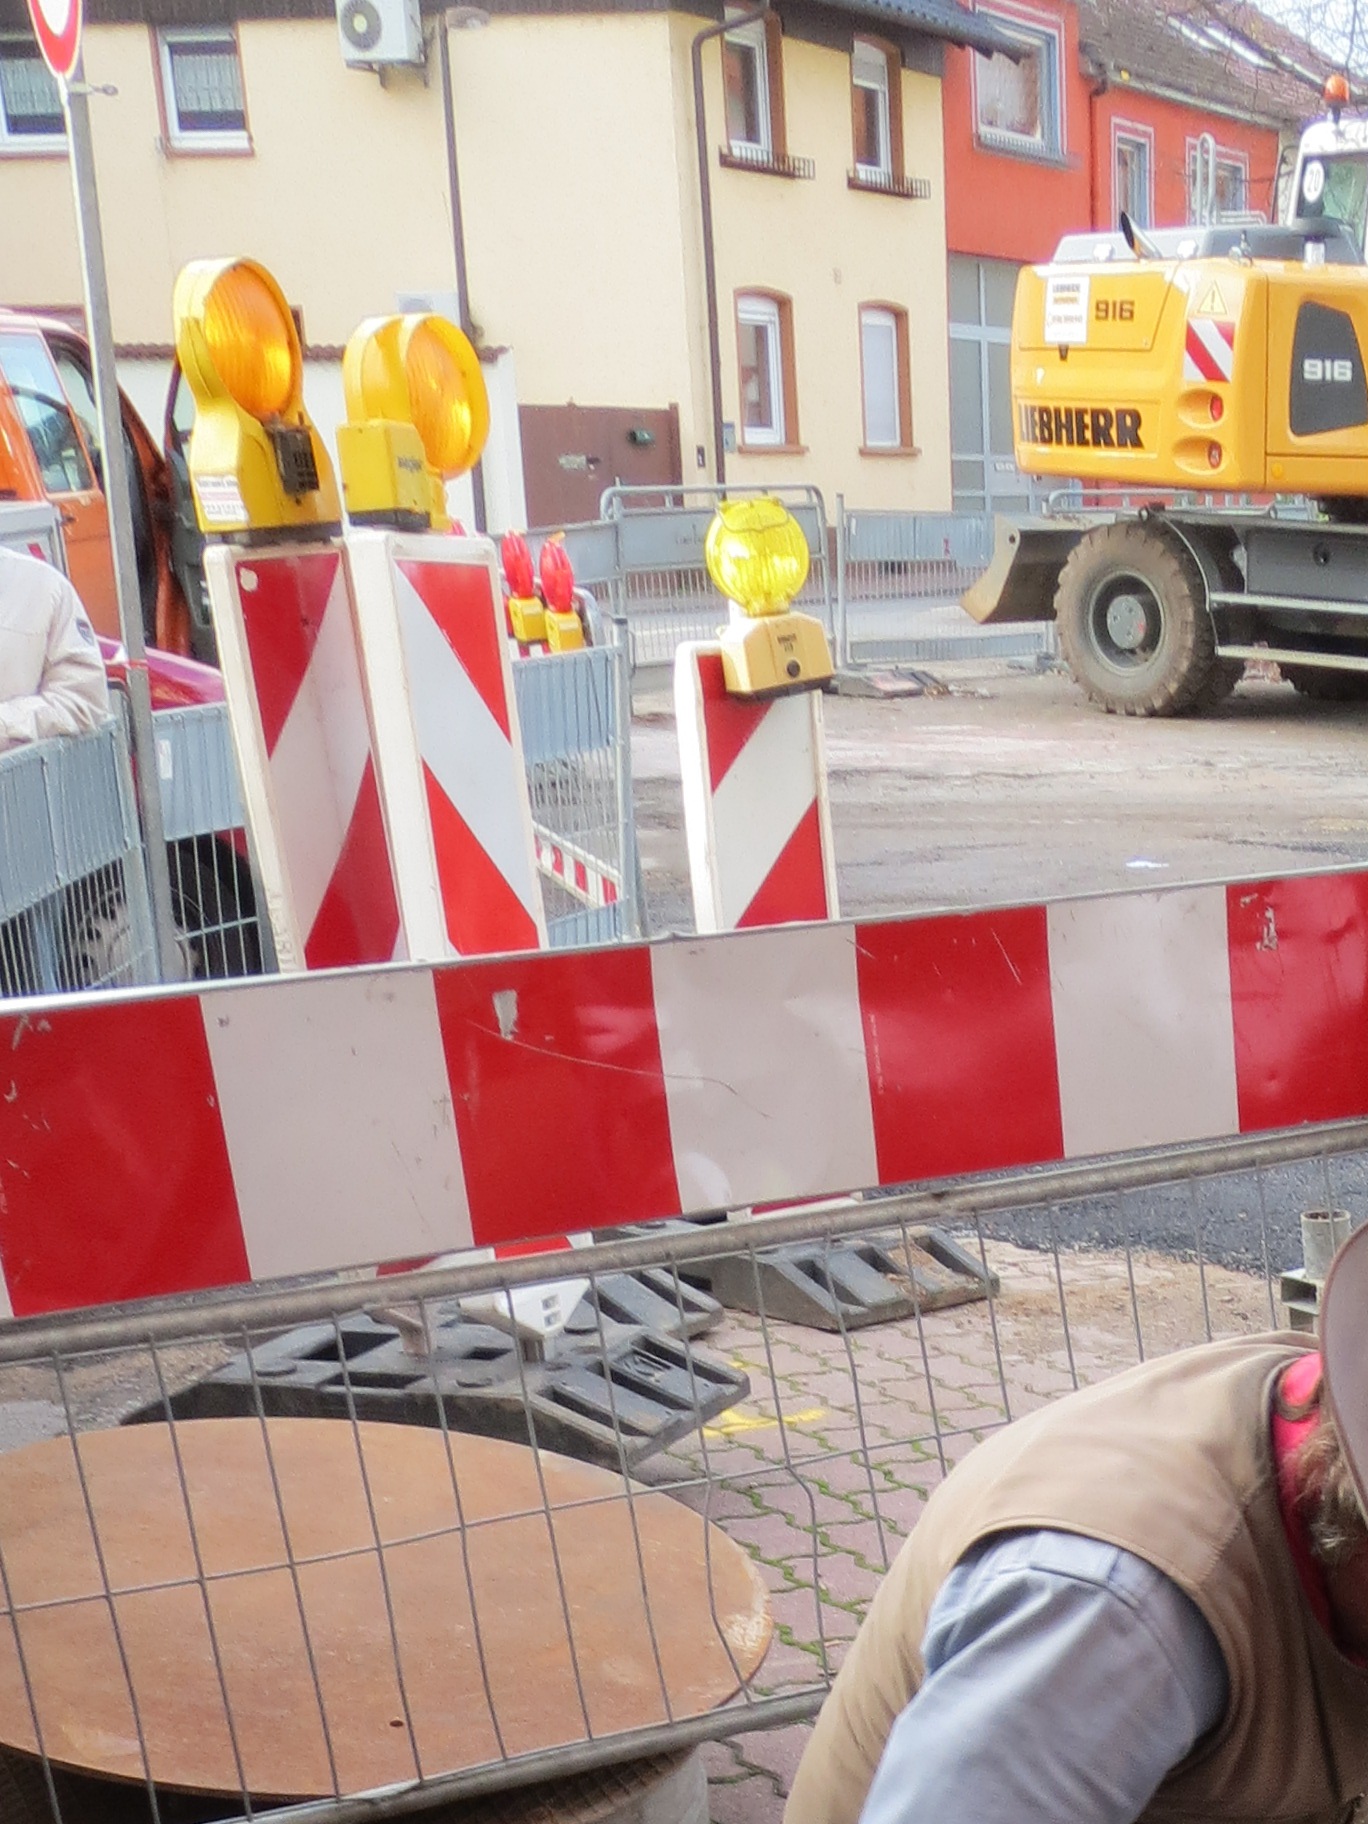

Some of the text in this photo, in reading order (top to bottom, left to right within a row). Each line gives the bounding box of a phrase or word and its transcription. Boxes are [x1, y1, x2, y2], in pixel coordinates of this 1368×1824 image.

[1308, 166, 1321, 193] 20
[1095, 300, 1135, 321] 916
[1303, 358, 1353, 382] 916
[1019, 403, 1145, 449] LIEBHERR
